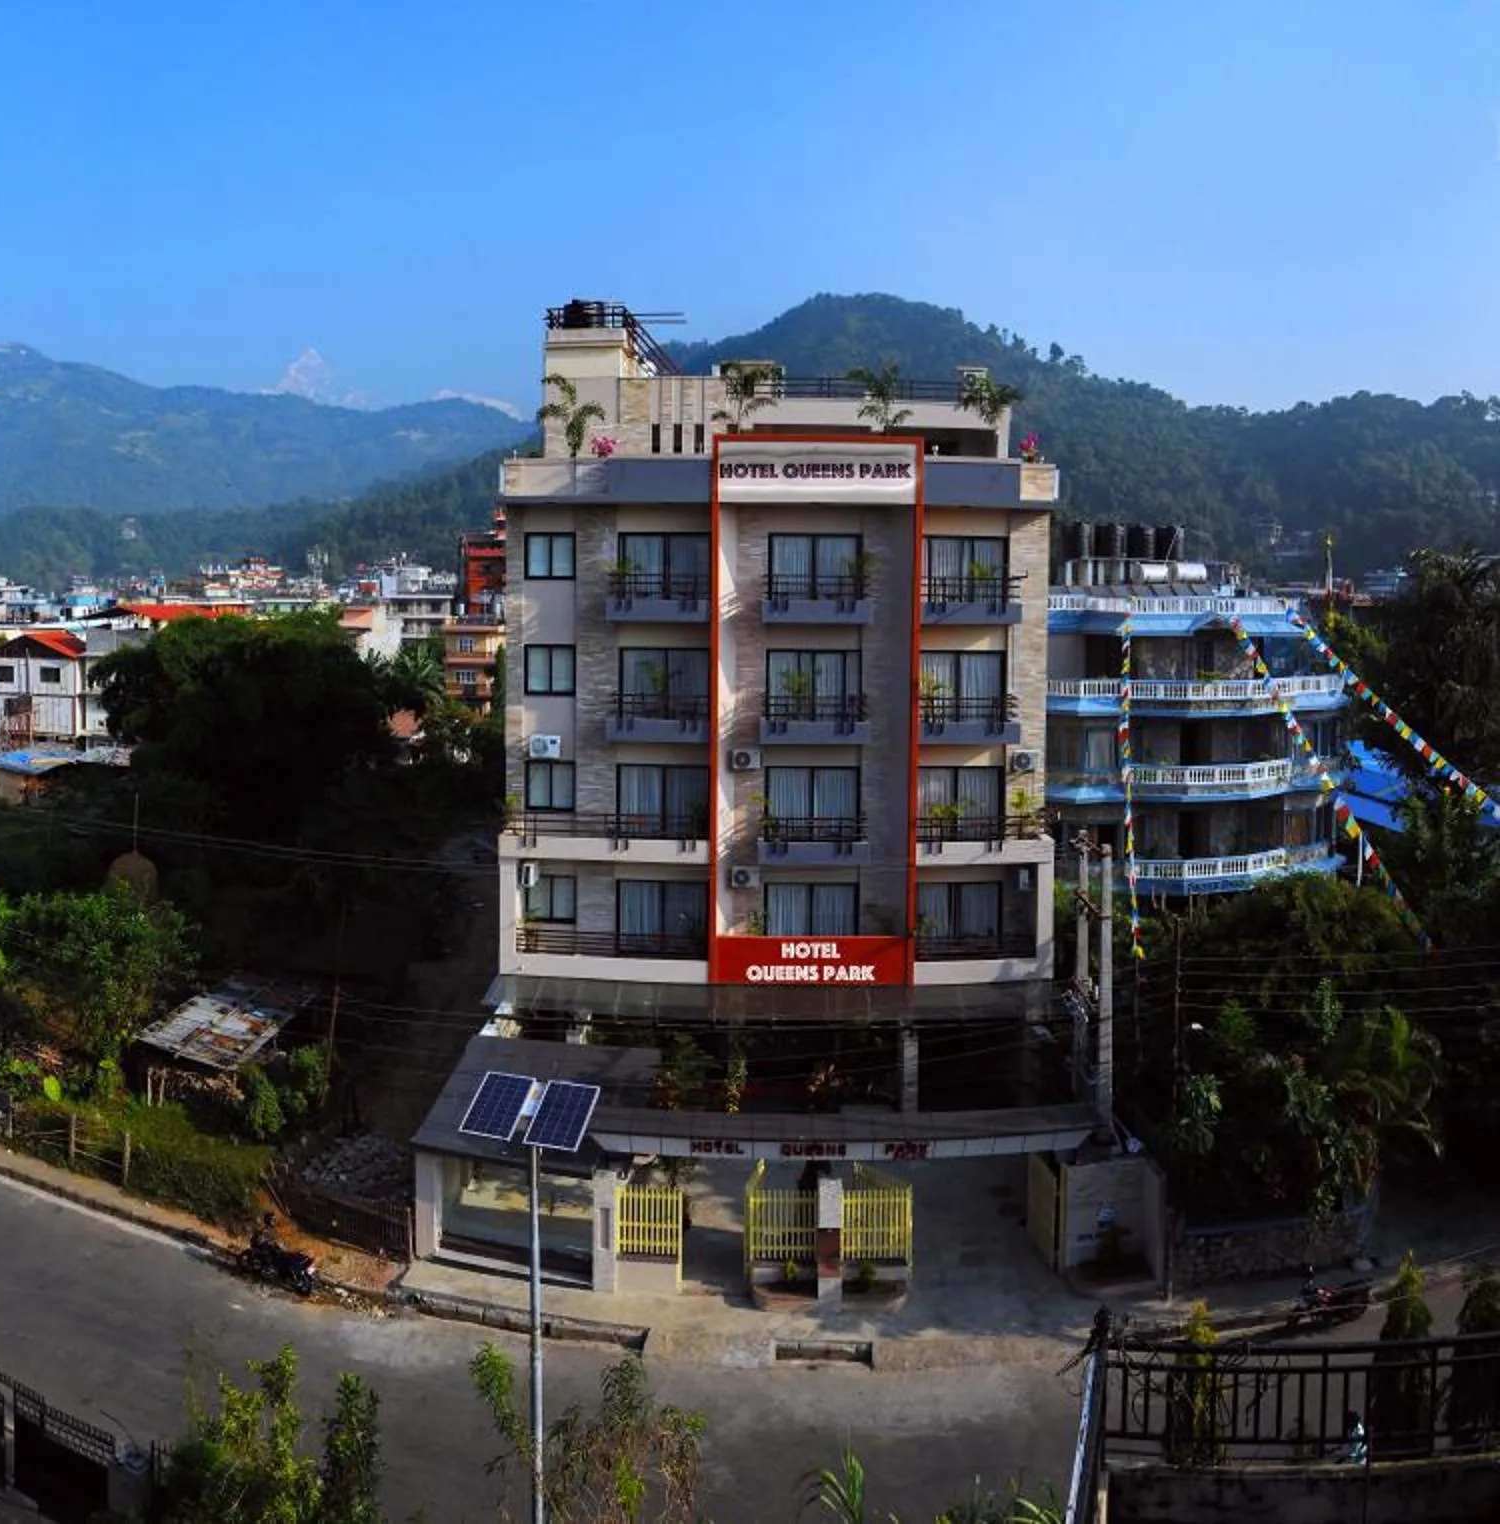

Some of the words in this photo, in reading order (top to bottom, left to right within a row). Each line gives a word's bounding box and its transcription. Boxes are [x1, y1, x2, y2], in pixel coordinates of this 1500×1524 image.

[719, 463, 778, 479] HOTEL
[782, 463, 855, 479] QUEENS
[859, 463, 912, 479] PARK
[780, 942, 841, 959] HOTEL
[745, 965, 819, 982] QUEENS
[823, 965, 875, 982] PARK
[690, 1140, 745, 1155] HOTEL
[780, 1142, 847, 1157] QUEENS
[884, 1142, 929, 1160] PARK
